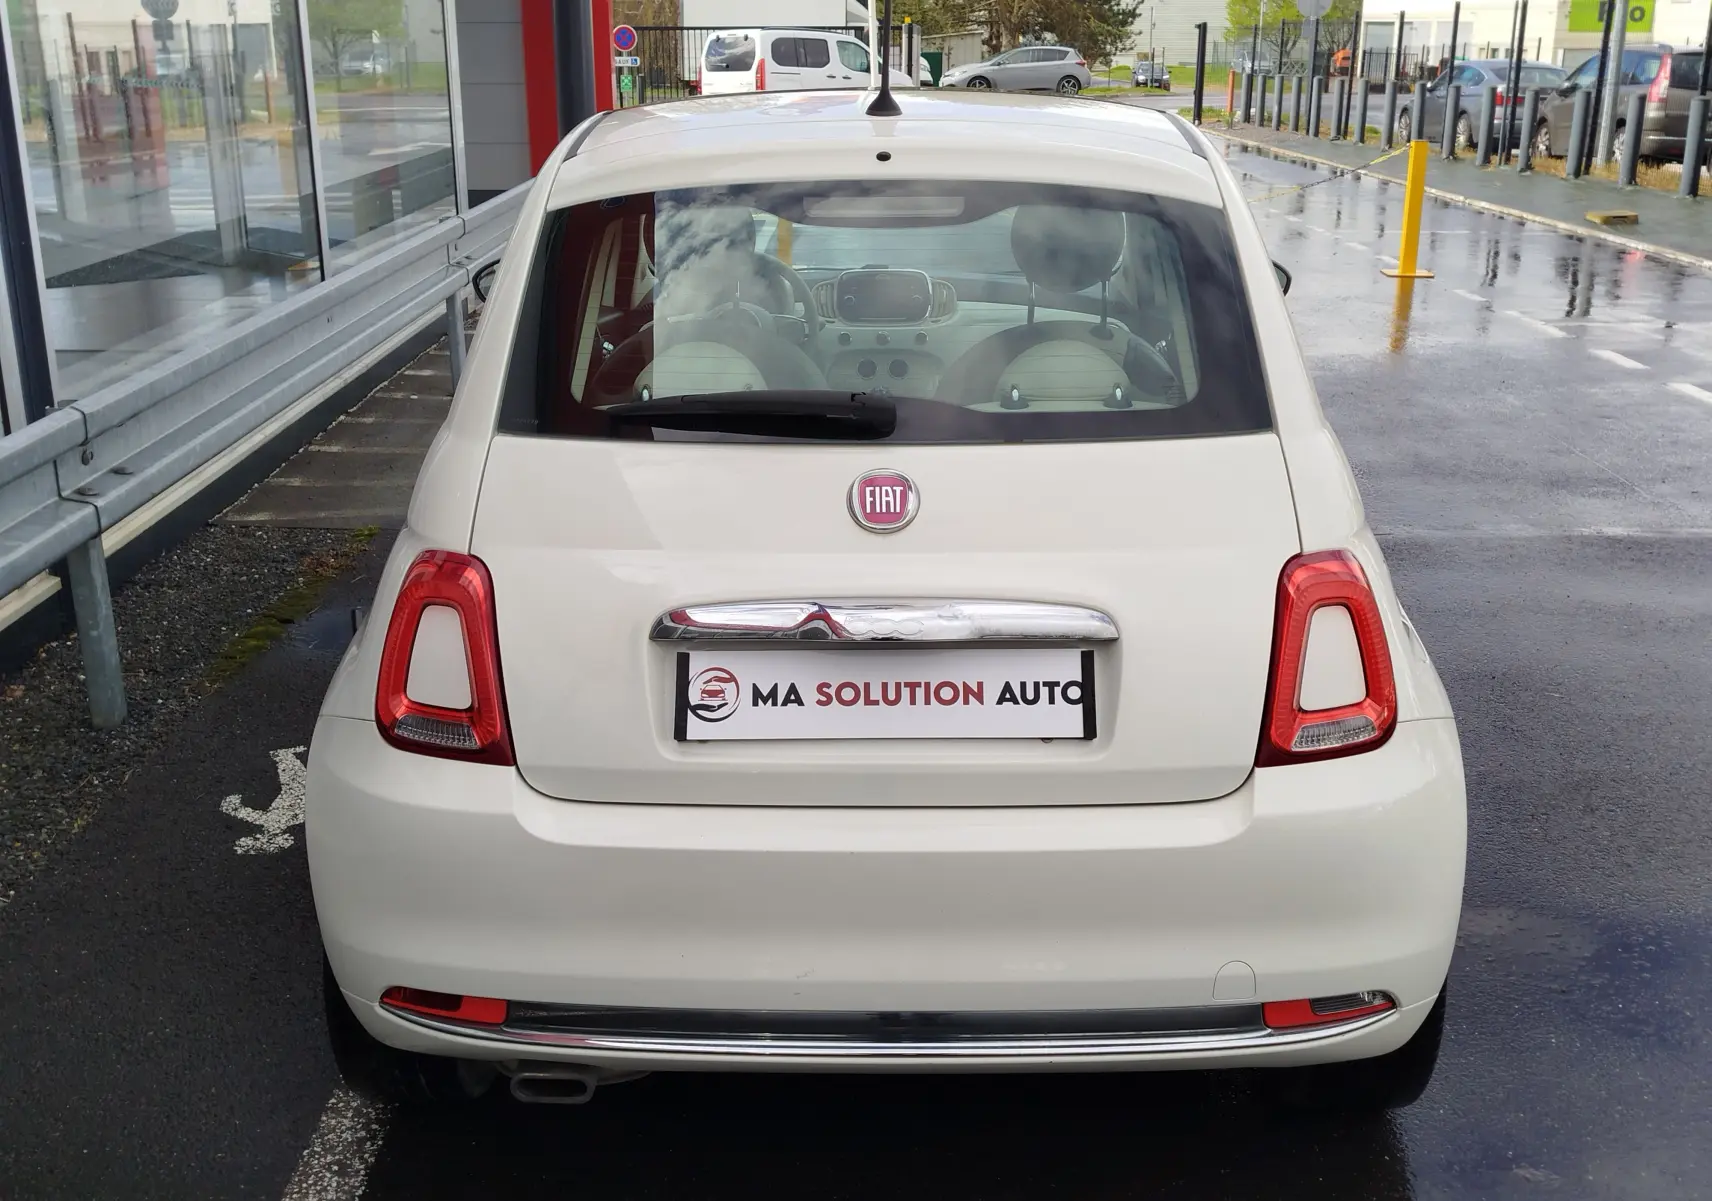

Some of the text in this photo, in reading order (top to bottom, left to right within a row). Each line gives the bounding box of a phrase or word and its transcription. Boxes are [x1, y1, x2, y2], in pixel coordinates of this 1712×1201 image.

[865, 486, 904, 513] FIAT
[752, 680, 1083, 707] MA SOLUTION AUTO
